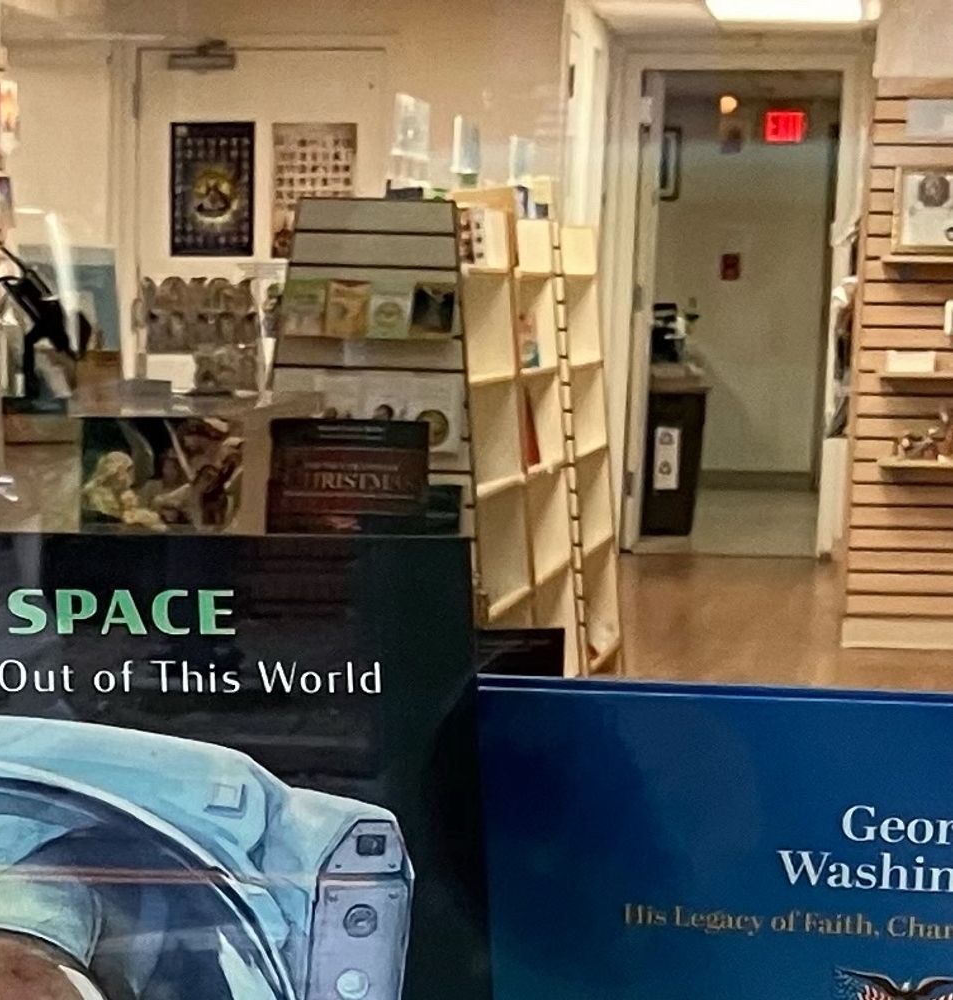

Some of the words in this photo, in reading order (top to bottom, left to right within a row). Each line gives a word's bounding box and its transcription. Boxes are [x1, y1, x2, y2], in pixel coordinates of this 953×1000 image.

[7, 589, 236, 635] SPACE
[93, 660, 134, 692] of
[150, 660, 241, 694] This
[258, 660, 382, 694] World
[624, 902, 666, 926] His
[674, 905, 764, 937] Legacy
[770, 909, 802, 932] of
